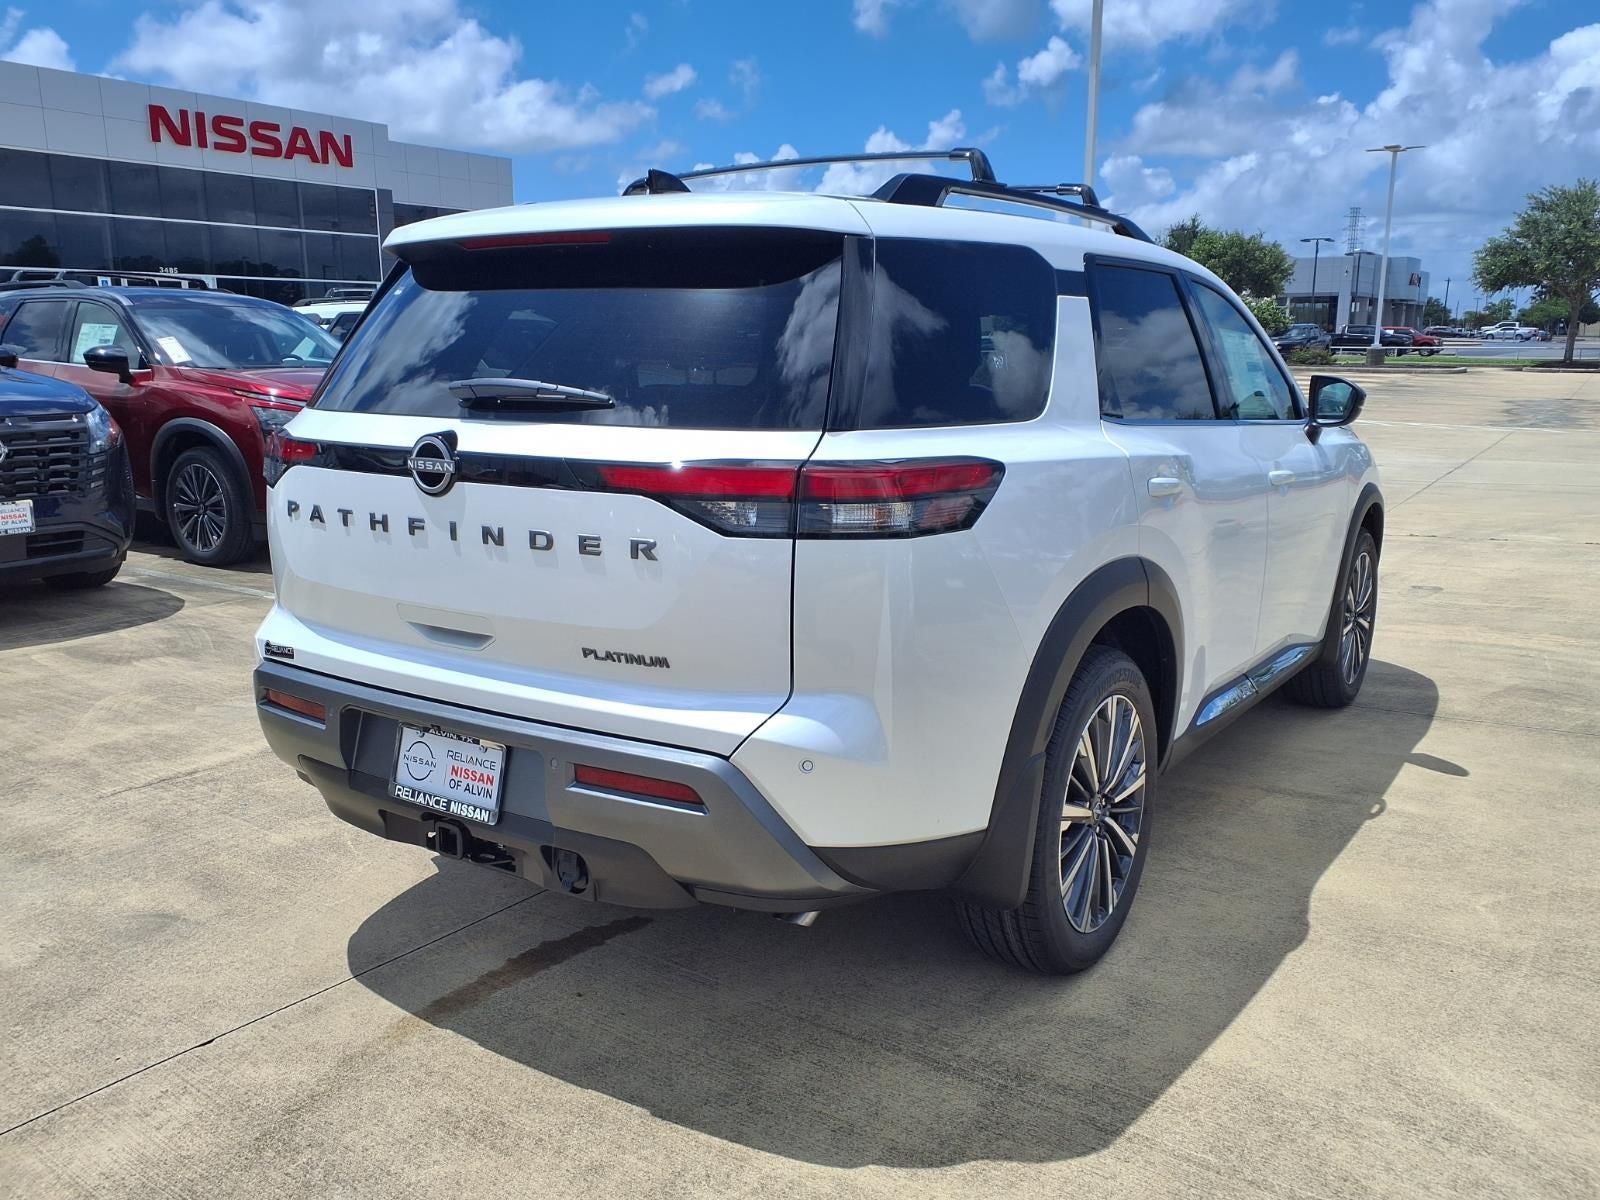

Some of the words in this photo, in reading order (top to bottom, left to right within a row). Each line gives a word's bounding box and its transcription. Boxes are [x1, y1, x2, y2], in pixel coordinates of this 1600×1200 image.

[148, 103, 354, 168] NISSAN
[407, 459, 454, 472] NISSAN
[287, 499, 658, 561] PATHFINDER
[582, 647, 670, 668] PLATINUM
[461, 735, 473, 743] TX
[404, 753, 437, 769] NISSAN
[447, 749, 497, 771] RELIANCE
[451, 765, 495, 786] NISSAN
[449, 778, 462, 790] OF
[464, 782, 493, 799] ALVIN
[395, 785, 448, 811] RELIANCE
[449, 800, 489, 822] NISSAN
